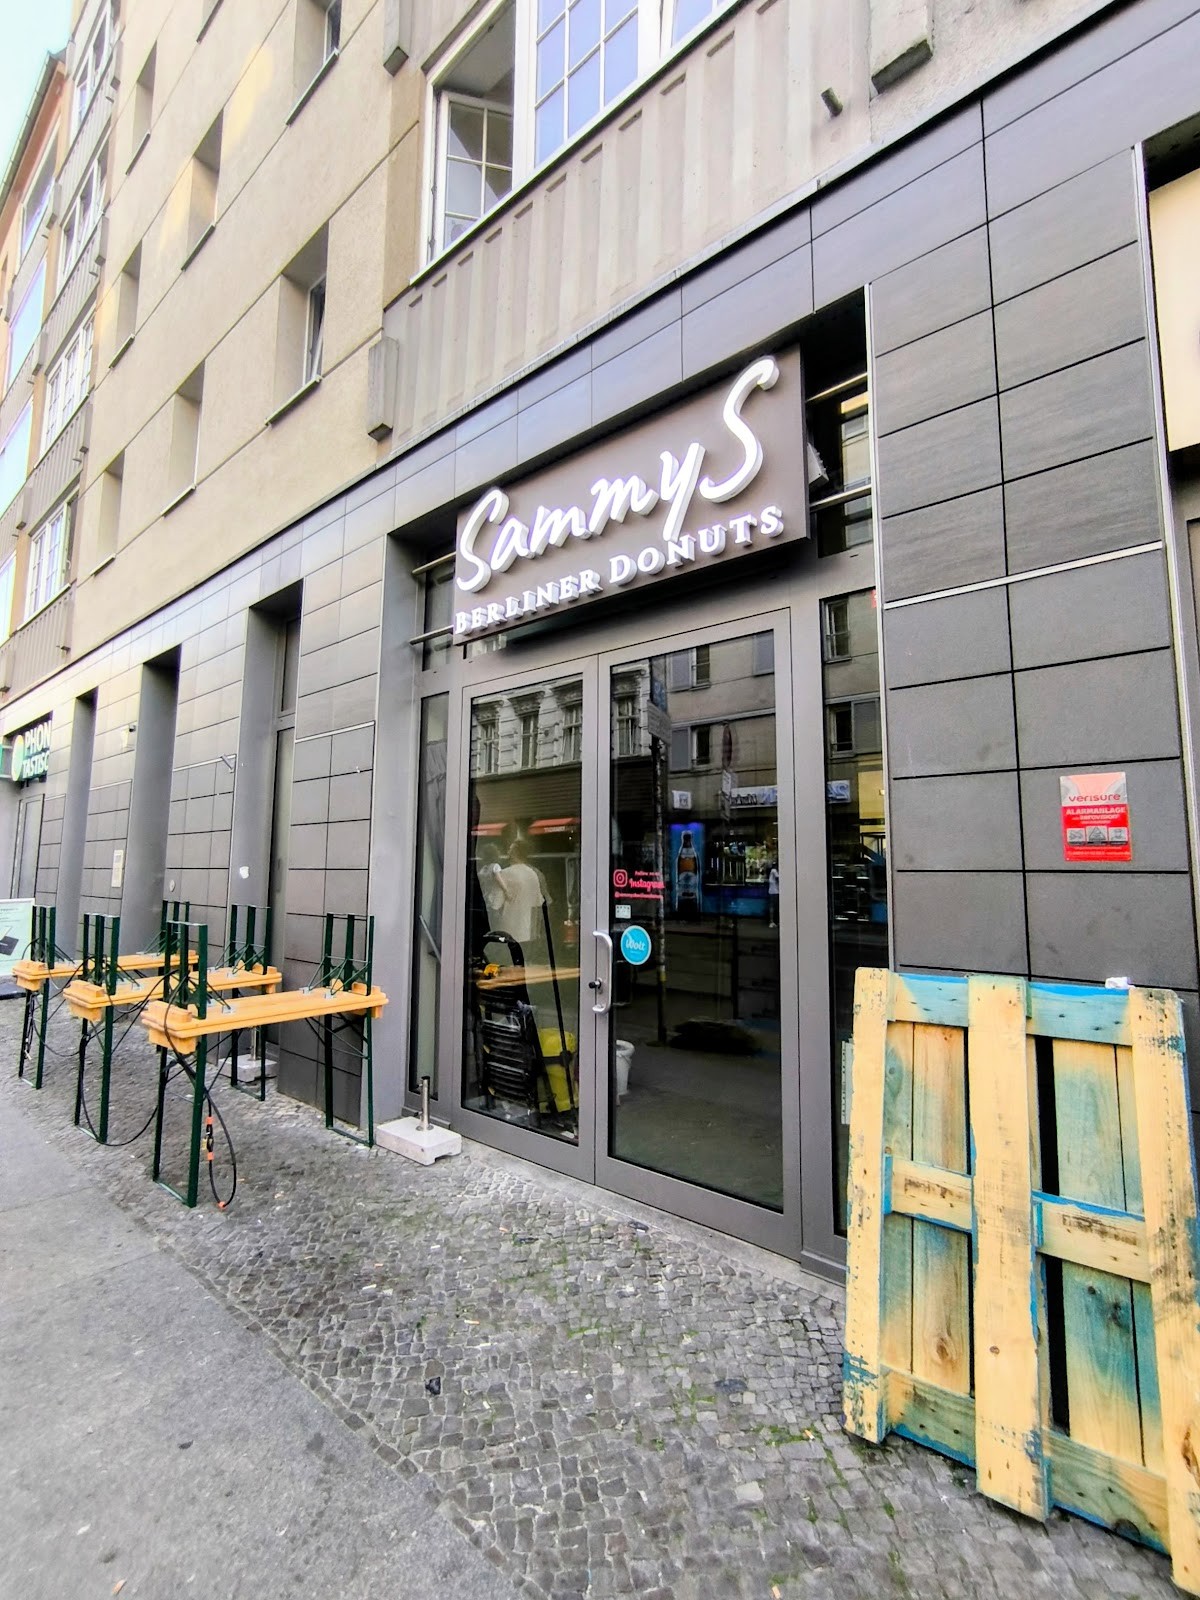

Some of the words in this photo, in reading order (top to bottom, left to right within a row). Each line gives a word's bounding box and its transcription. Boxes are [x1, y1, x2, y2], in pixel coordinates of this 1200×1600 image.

[454, 568, 603, 636] BERLINER
[609, 505, 785, 586] DONUTS
[1069, 793, 1121, 802] verisure
